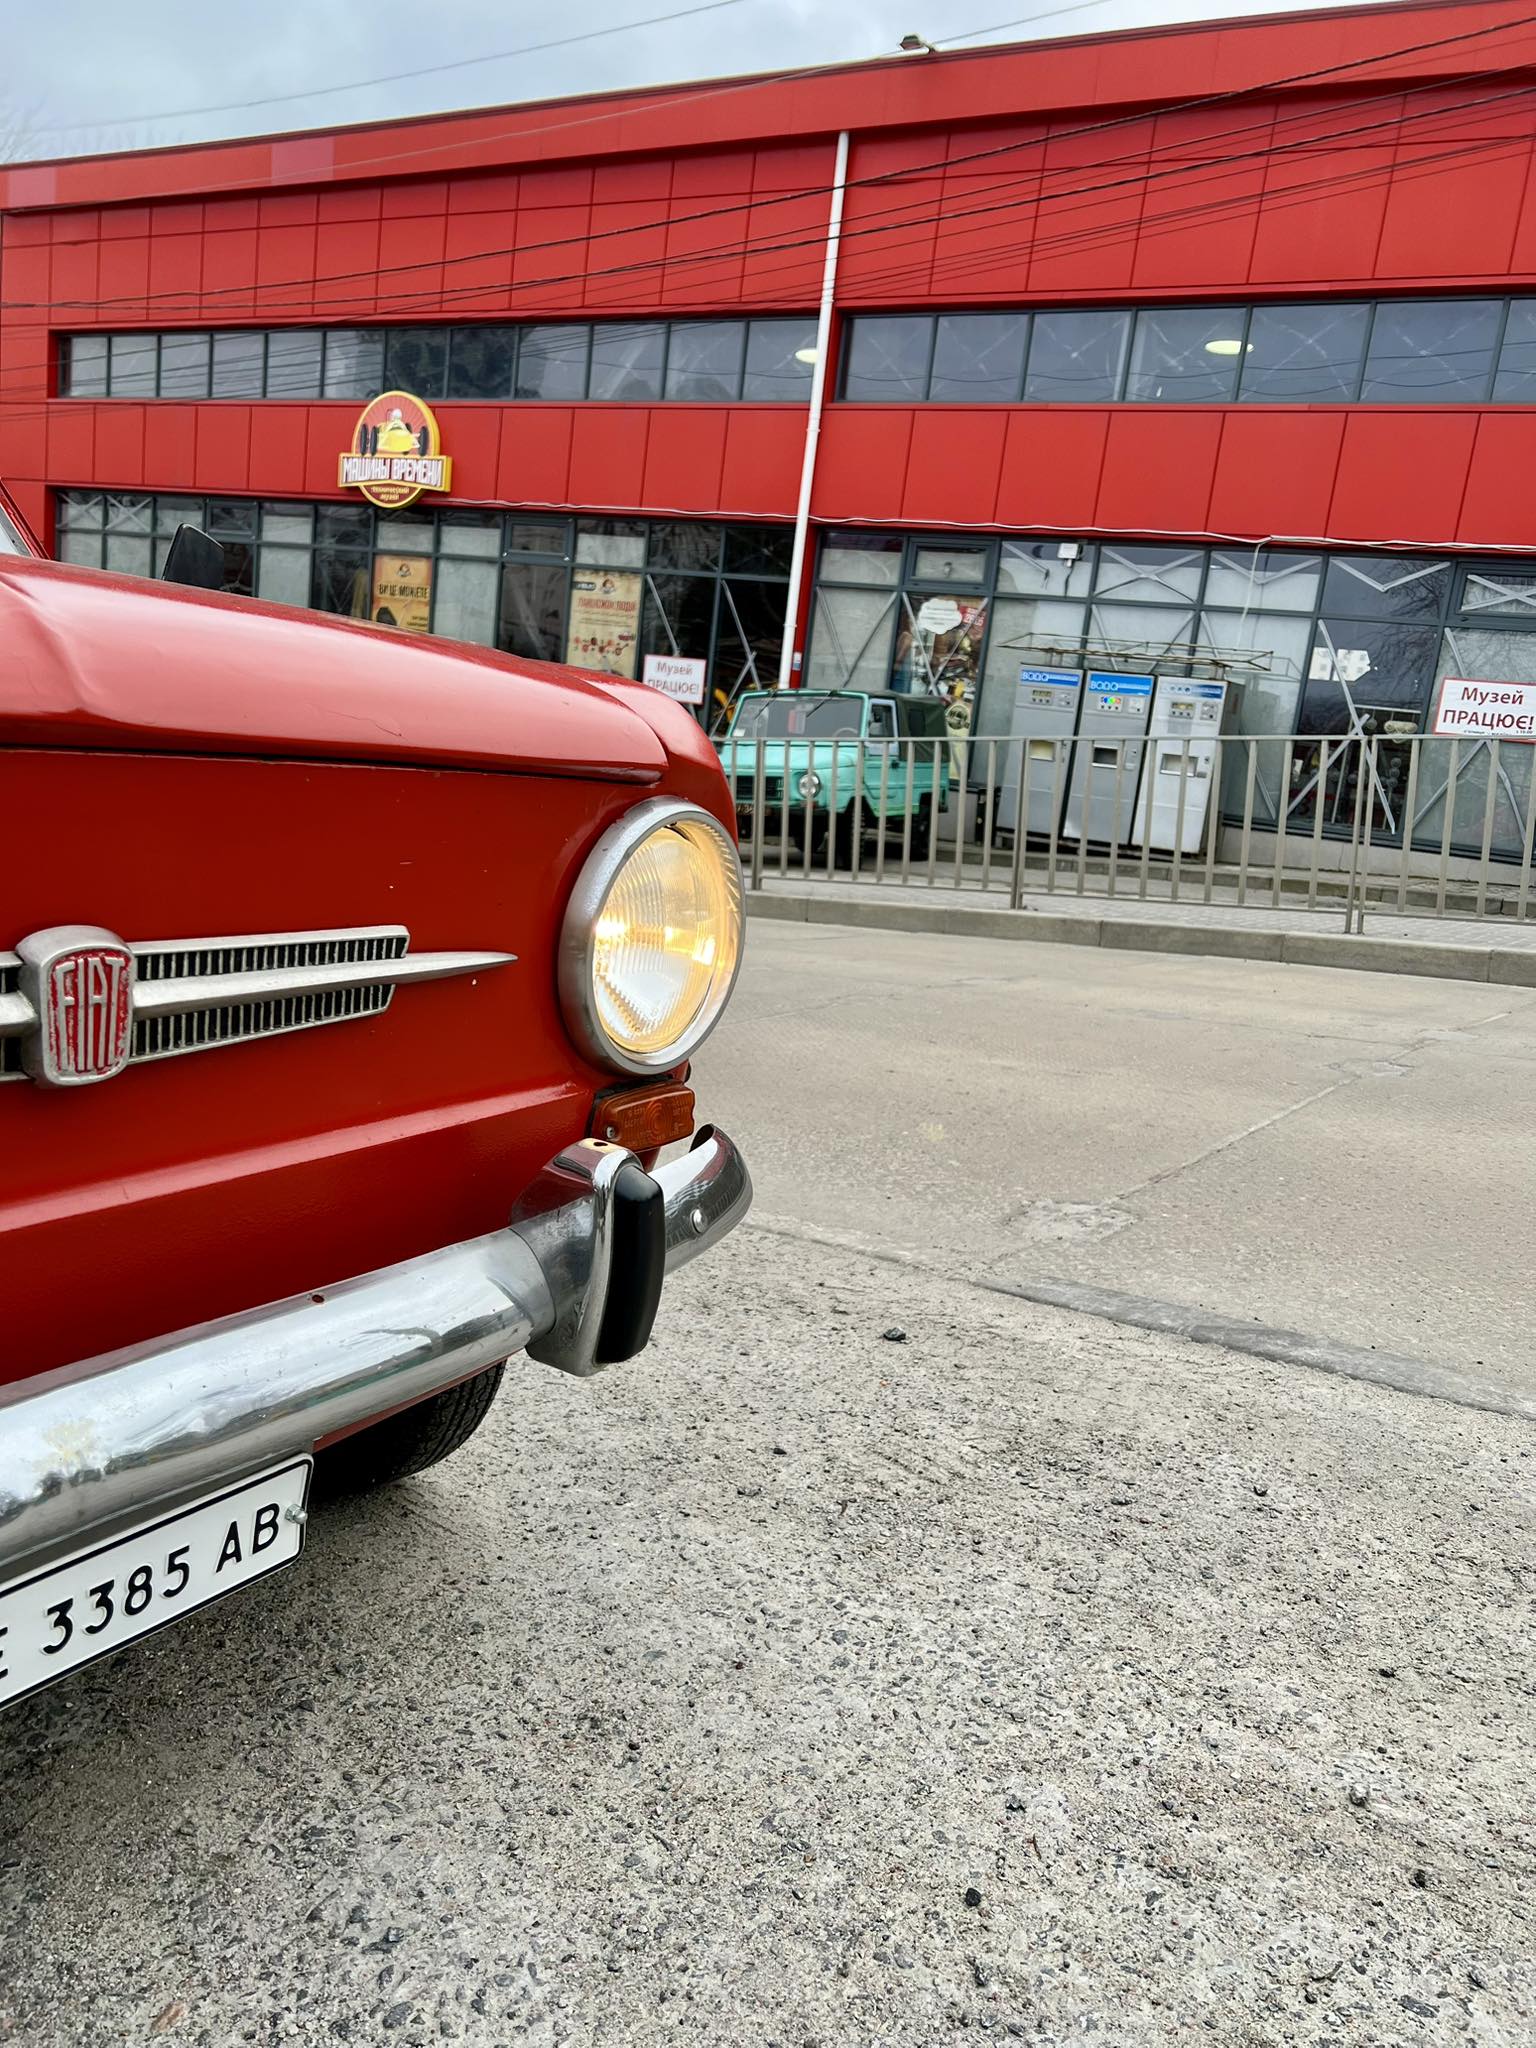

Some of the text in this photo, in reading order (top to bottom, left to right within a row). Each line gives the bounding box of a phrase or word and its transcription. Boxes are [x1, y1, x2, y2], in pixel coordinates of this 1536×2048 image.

[343, 458, 442, 486] МАШИНЫ ВРЕМЕНИ
[657, 661, 693, 675] Музей
[1461, 687, 1524, 705] Музей
[1443, 709, 1534, 730] ПРАЦЮЄ!
[55, 957, 126, 1071] FIAT
[42, 1545, 190, 1654] 3385
[215, 1503, 280, 1573] AB
